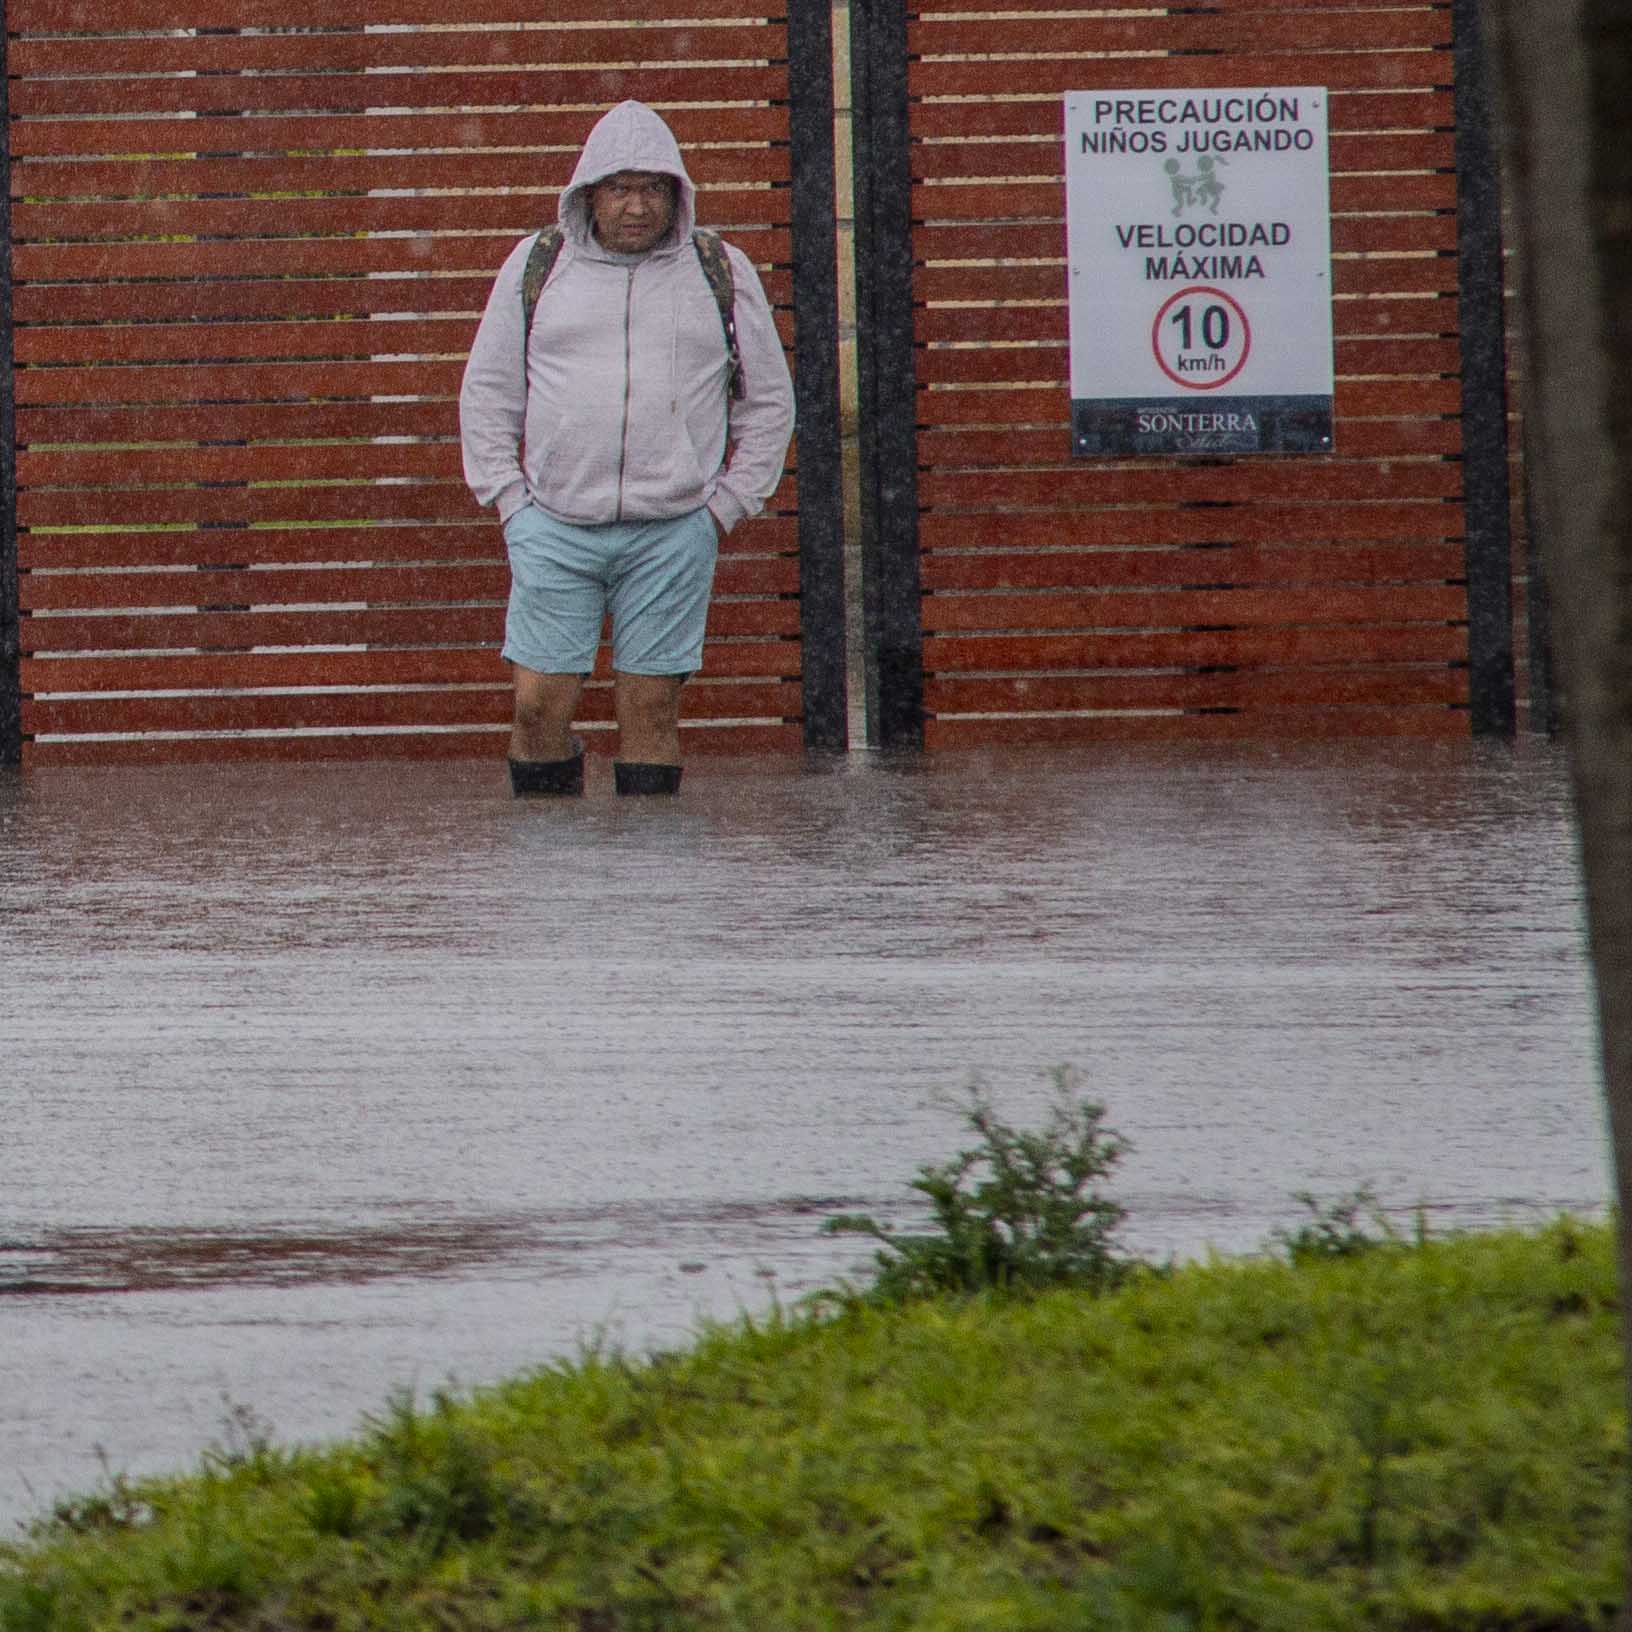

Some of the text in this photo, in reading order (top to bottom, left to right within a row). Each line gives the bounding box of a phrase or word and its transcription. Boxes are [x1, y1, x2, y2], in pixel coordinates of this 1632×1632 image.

[1094, 91, 1300, 125] PRECAUCIÓN
[1081, 126, 1314, 154] NIÑOS JUGANDO
[1115, 222, 1292, 249] VELOCIDAD
[1145, 250, 1266, 281] MÁXIMA
[1171, 304, 1231, 351] 10
[1177, 353, 1226, 372] km/h
[1138, 413, 1257, 433] SONTERRA
